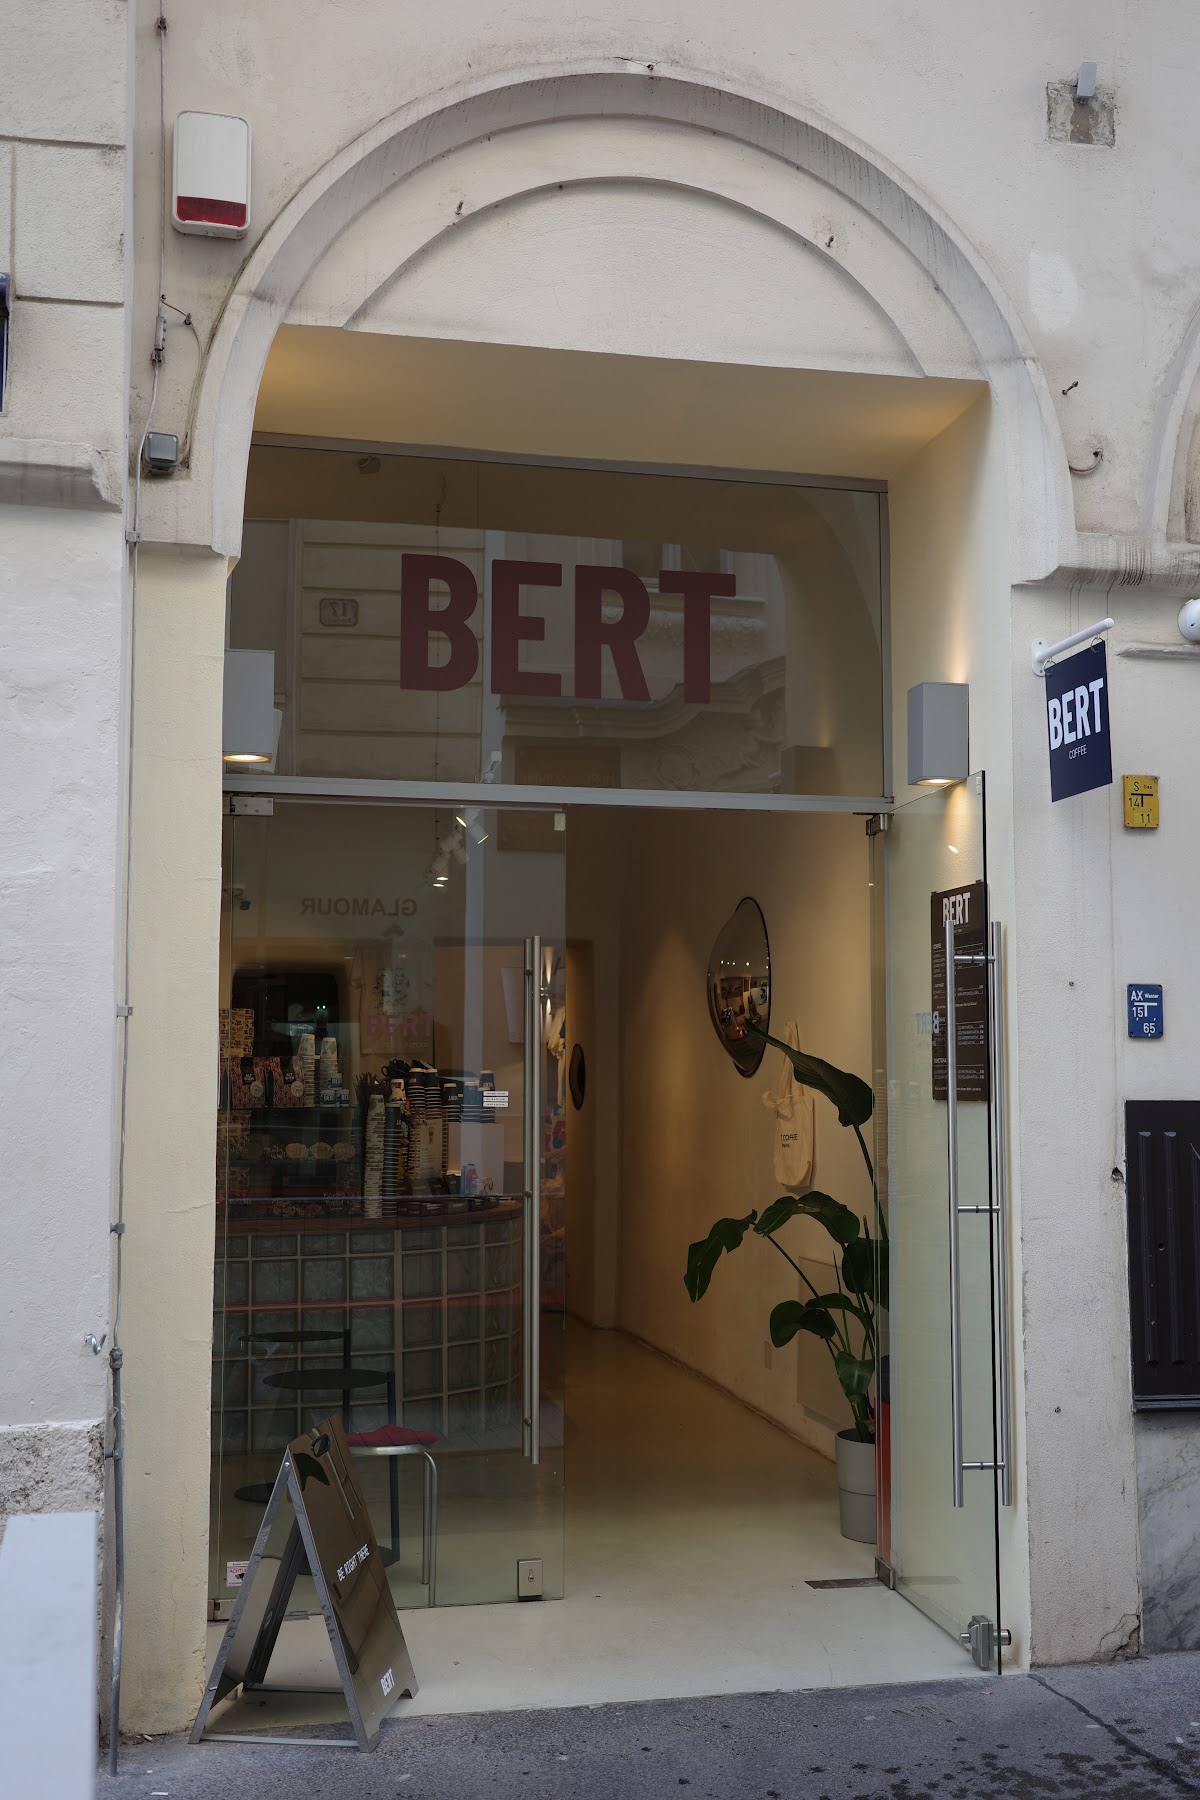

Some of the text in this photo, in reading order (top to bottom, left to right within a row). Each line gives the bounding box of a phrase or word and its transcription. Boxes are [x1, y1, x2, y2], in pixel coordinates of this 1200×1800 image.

[400, 553, 736, 704] BERT
[1048, 677, 1104, 751] BERT
[1068, 744, 1088, 760] COFFEE
[1133, 781, 1140, 792] S
[942, 891, 971, 928] BERT
[1130, 990, 1144, 1001] AX
[380, 1667, 395, 1697] BERT
